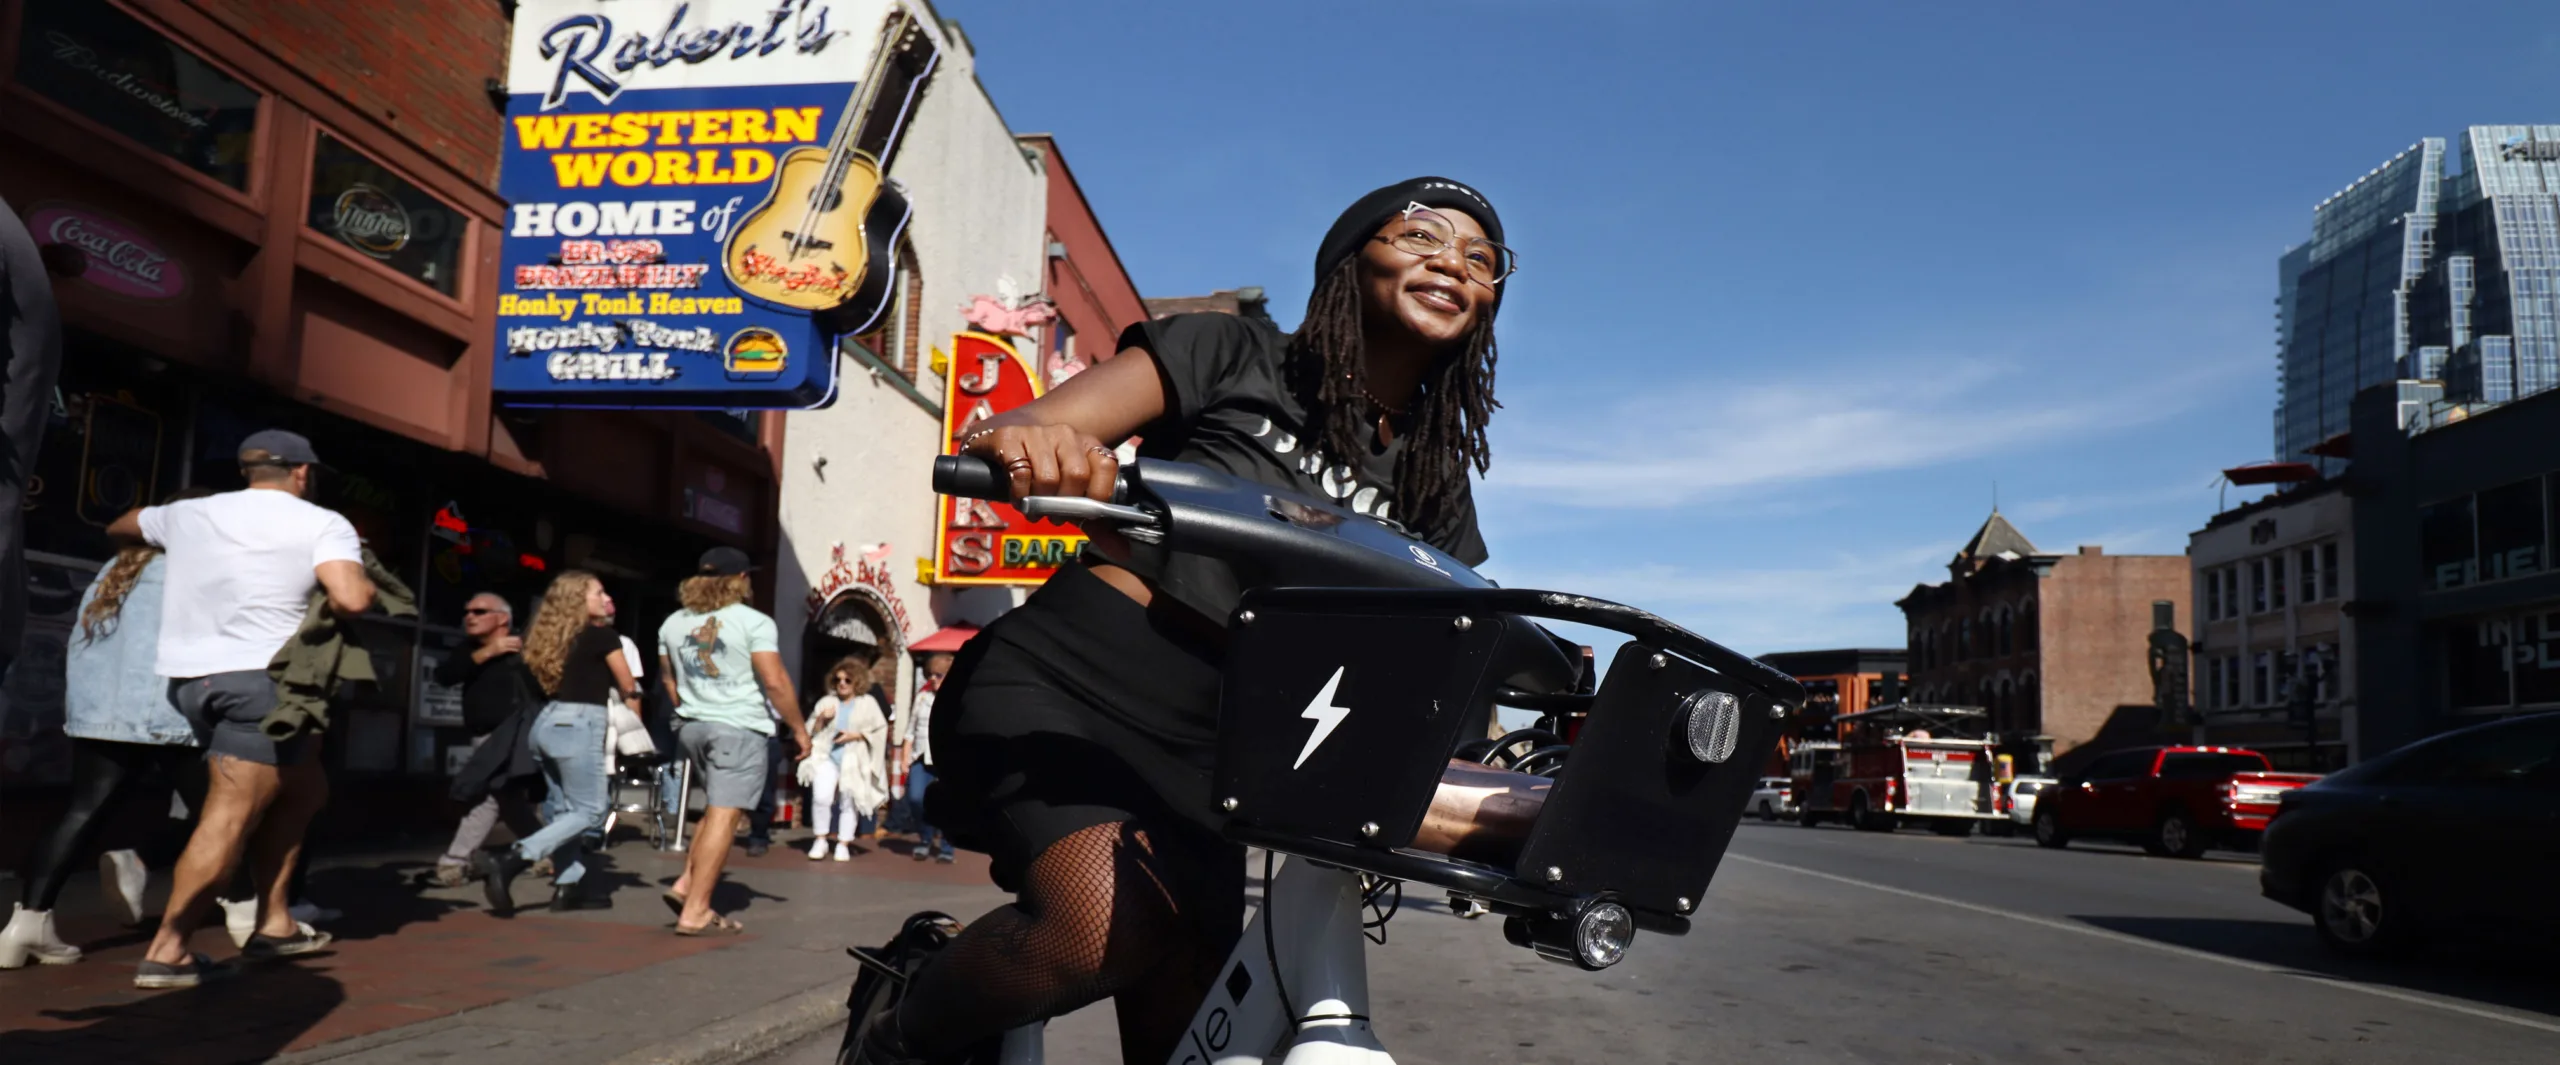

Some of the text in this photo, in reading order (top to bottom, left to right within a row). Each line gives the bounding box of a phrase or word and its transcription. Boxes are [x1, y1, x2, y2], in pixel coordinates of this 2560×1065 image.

[46, 31, 208, 129] Budweiser
[513, 106, 823, 151] WESTERN
[551, 149, 776, 189] WORLD
[511, 196, 744, 243] HOME of
[49, 216, 167, 282] Coca-Cola
[497, 291, 743, 322] Honky Tonk Heaven
[546, 351, 676, 380] GRILL
[950, 353, 1010, 576] JAKS
